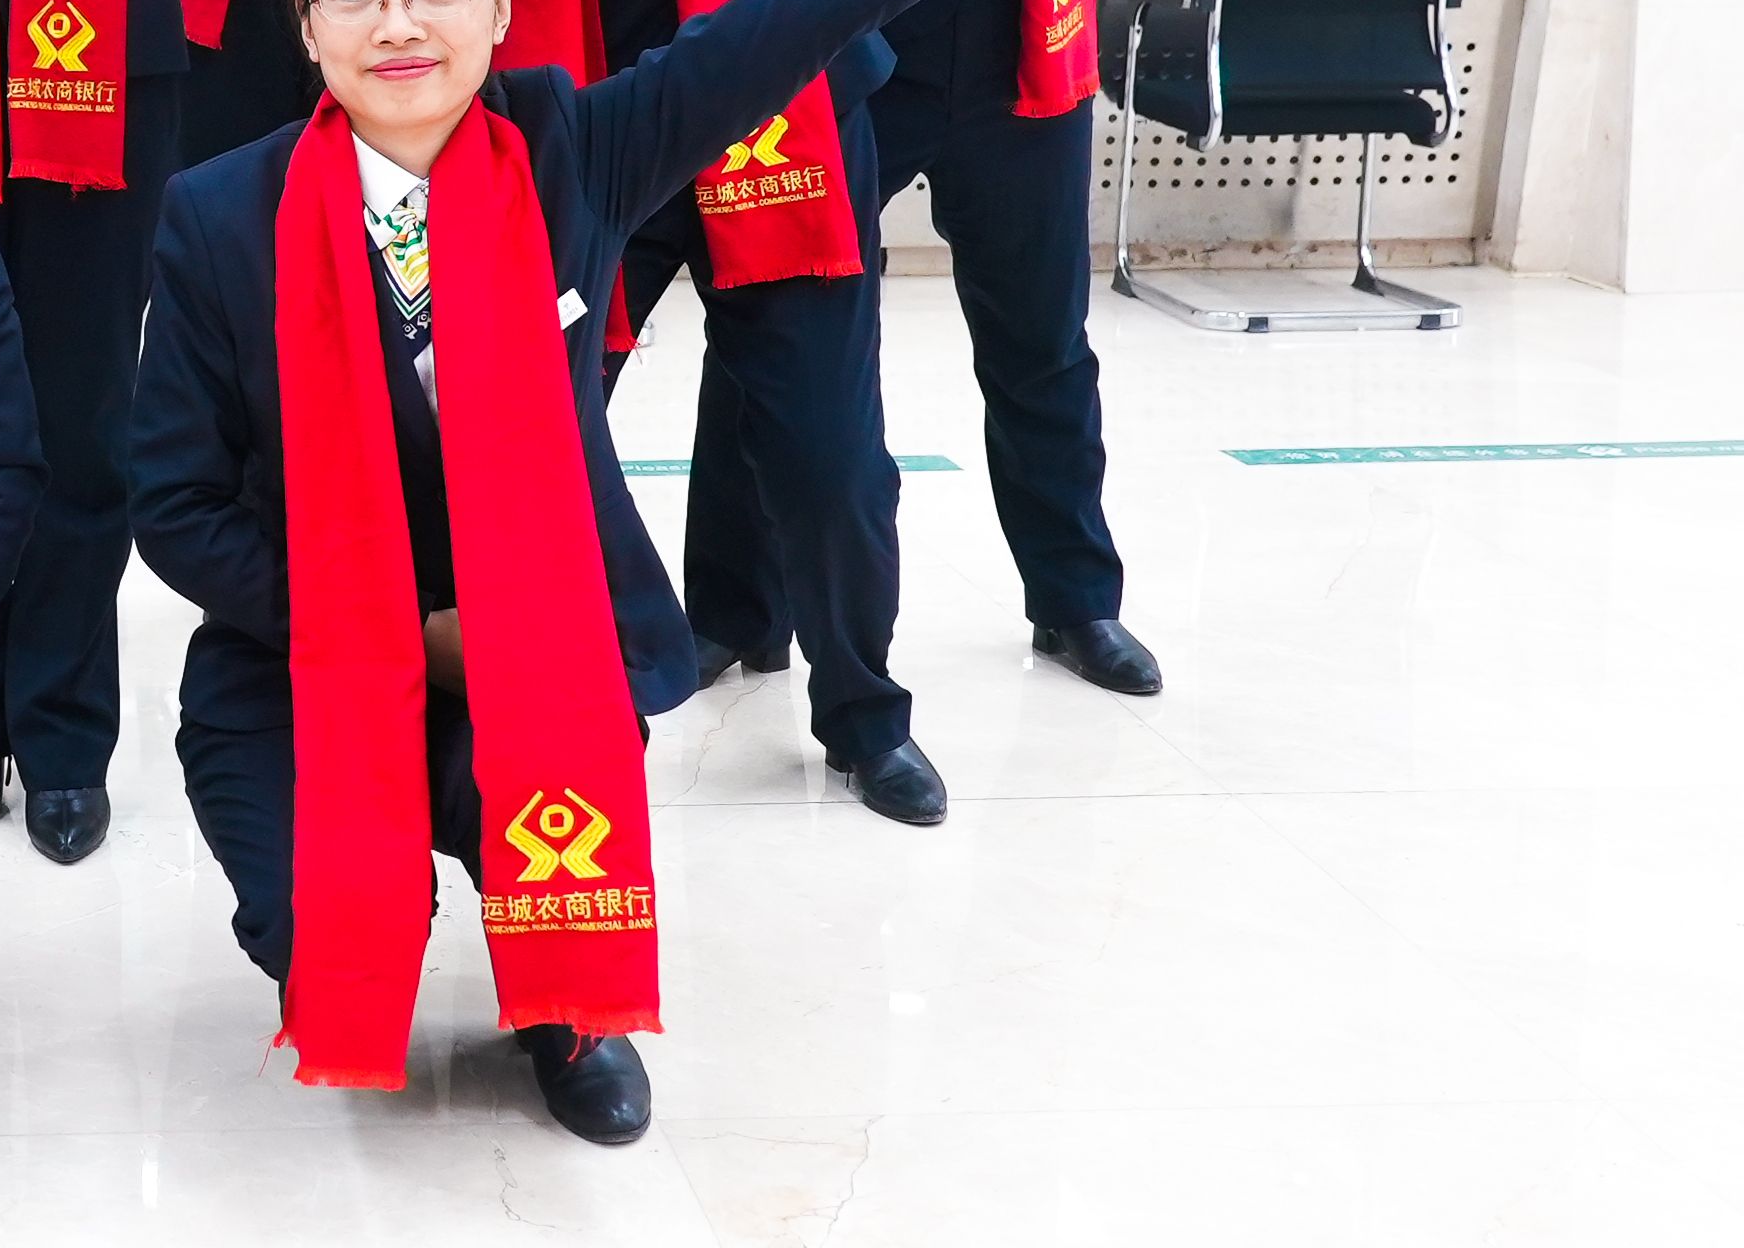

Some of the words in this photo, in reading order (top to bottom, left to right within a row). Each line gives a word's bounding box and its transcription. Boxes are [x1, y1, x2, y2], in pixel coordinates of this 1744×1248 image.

[7, 77, 117, 102] 运城农商银行
[696, 165, 825, 205] 运城农商银行
[482, 886, 652, 923] 运城农商银行
[565, 920, 623, 932] COMMERCIAL
[627, 917, 655, 930] BANK
